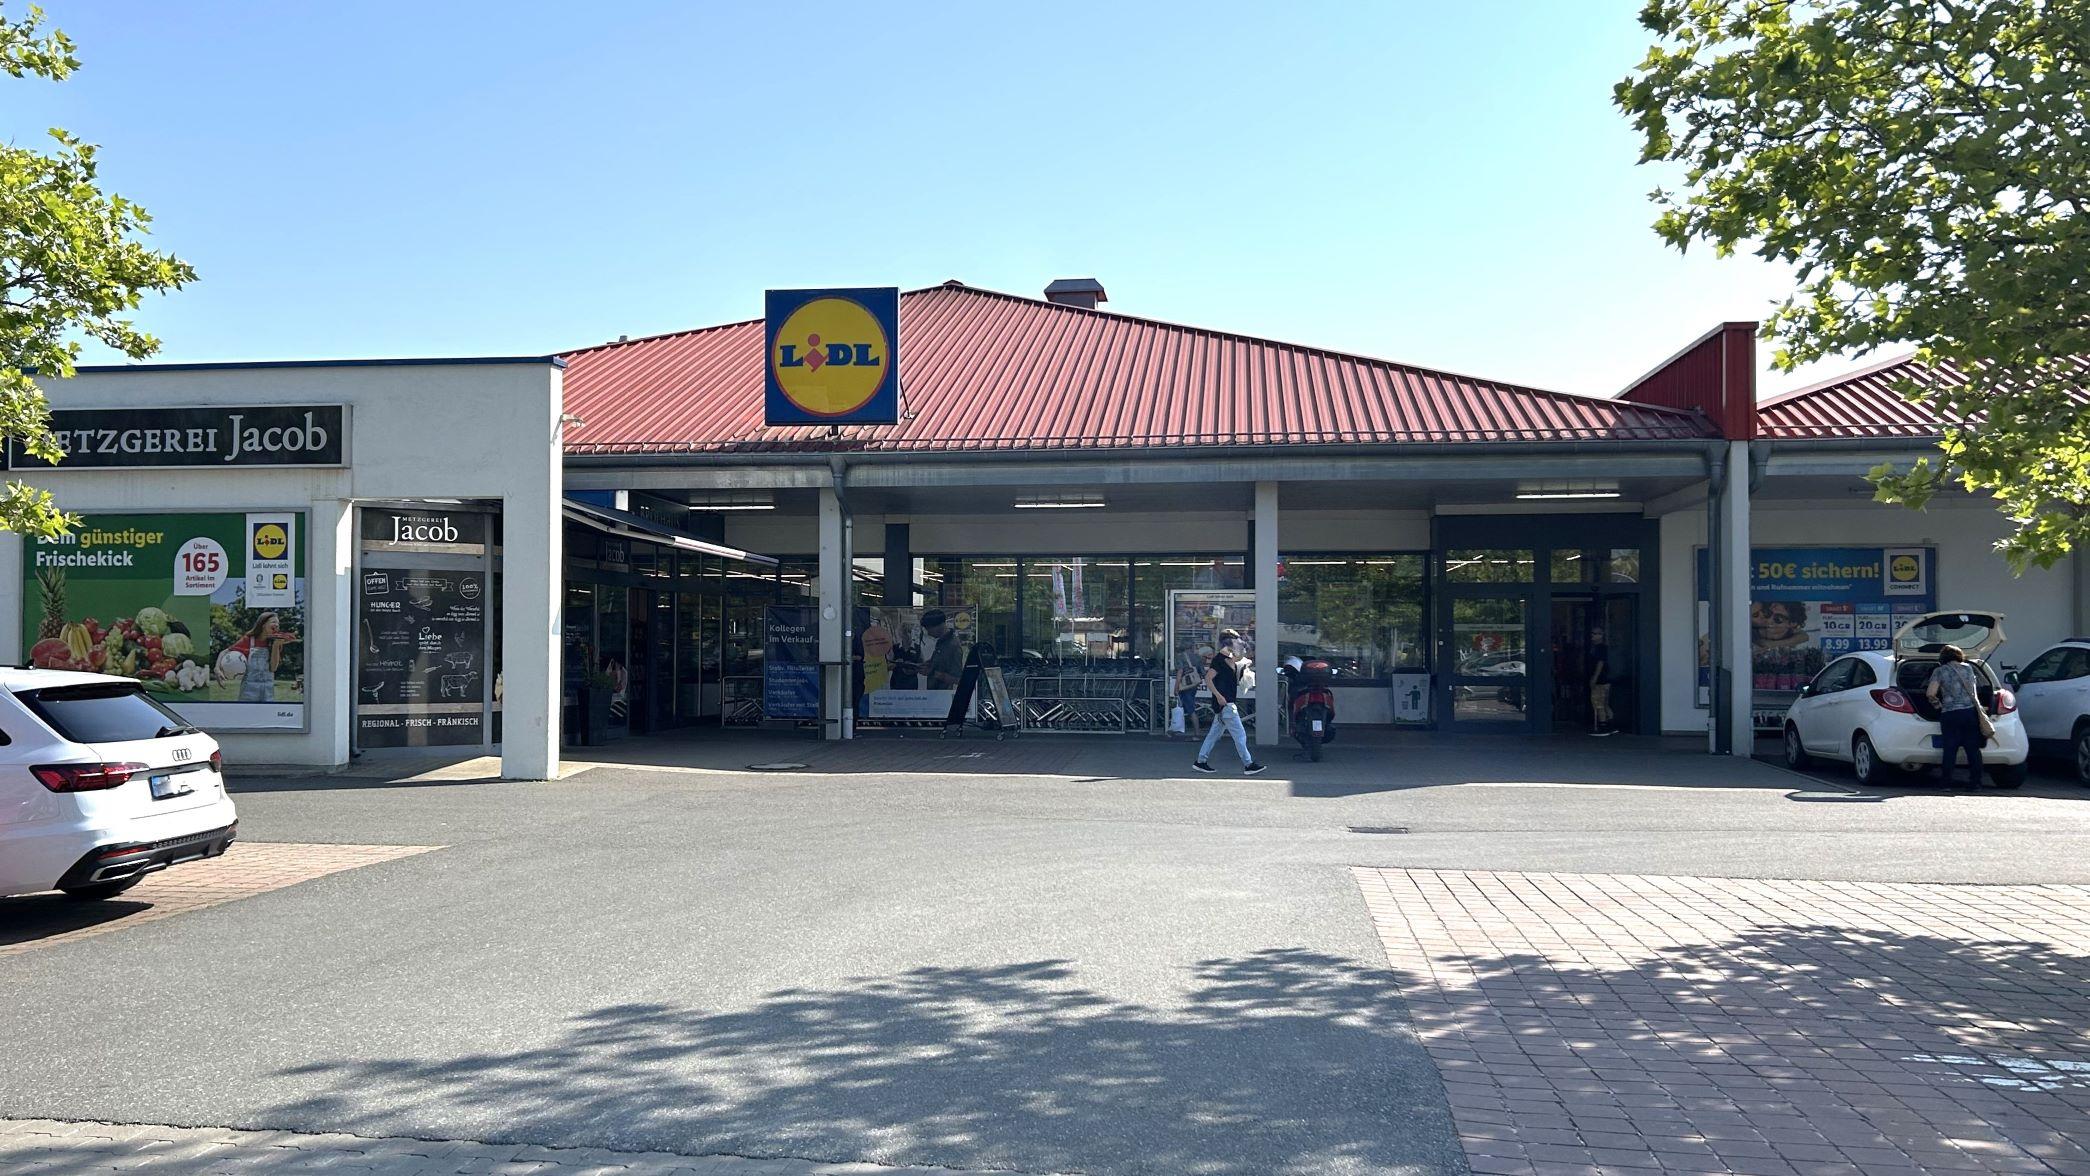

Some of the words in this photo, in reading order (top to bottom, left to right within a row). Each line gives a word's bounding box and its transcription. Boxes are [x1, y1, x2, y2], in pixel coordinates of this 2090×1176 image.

[45, 429, 218, 454] ETZGEREI
[224, 411, 328, 461] Jacob
[389, 516, 458, 546] Jacob
[80, 528, 164, 549] günstiger
[36, 550, 134, 567] Frischekick
[182, 553, 219, 572] 165
[1758, 562, 1797, 579] 50€
[1801, 562, 1880, 579] sichern!
[769, 624, 806, 634] Kollegen
[1823, 621, 1837, 630] 10
[1858, 621, 1873, 630] 20
[781, 635, 814, 643] Verkauf
[1825, 639, 1850, 650] 8.99
[1858, 639, 1888, 650] 13.99
[362, 719, 400, 728] REGIONAL
[405, 718, 432, 727] FRISCH
[437, 717, 479, 726] FRÄNKISCH
